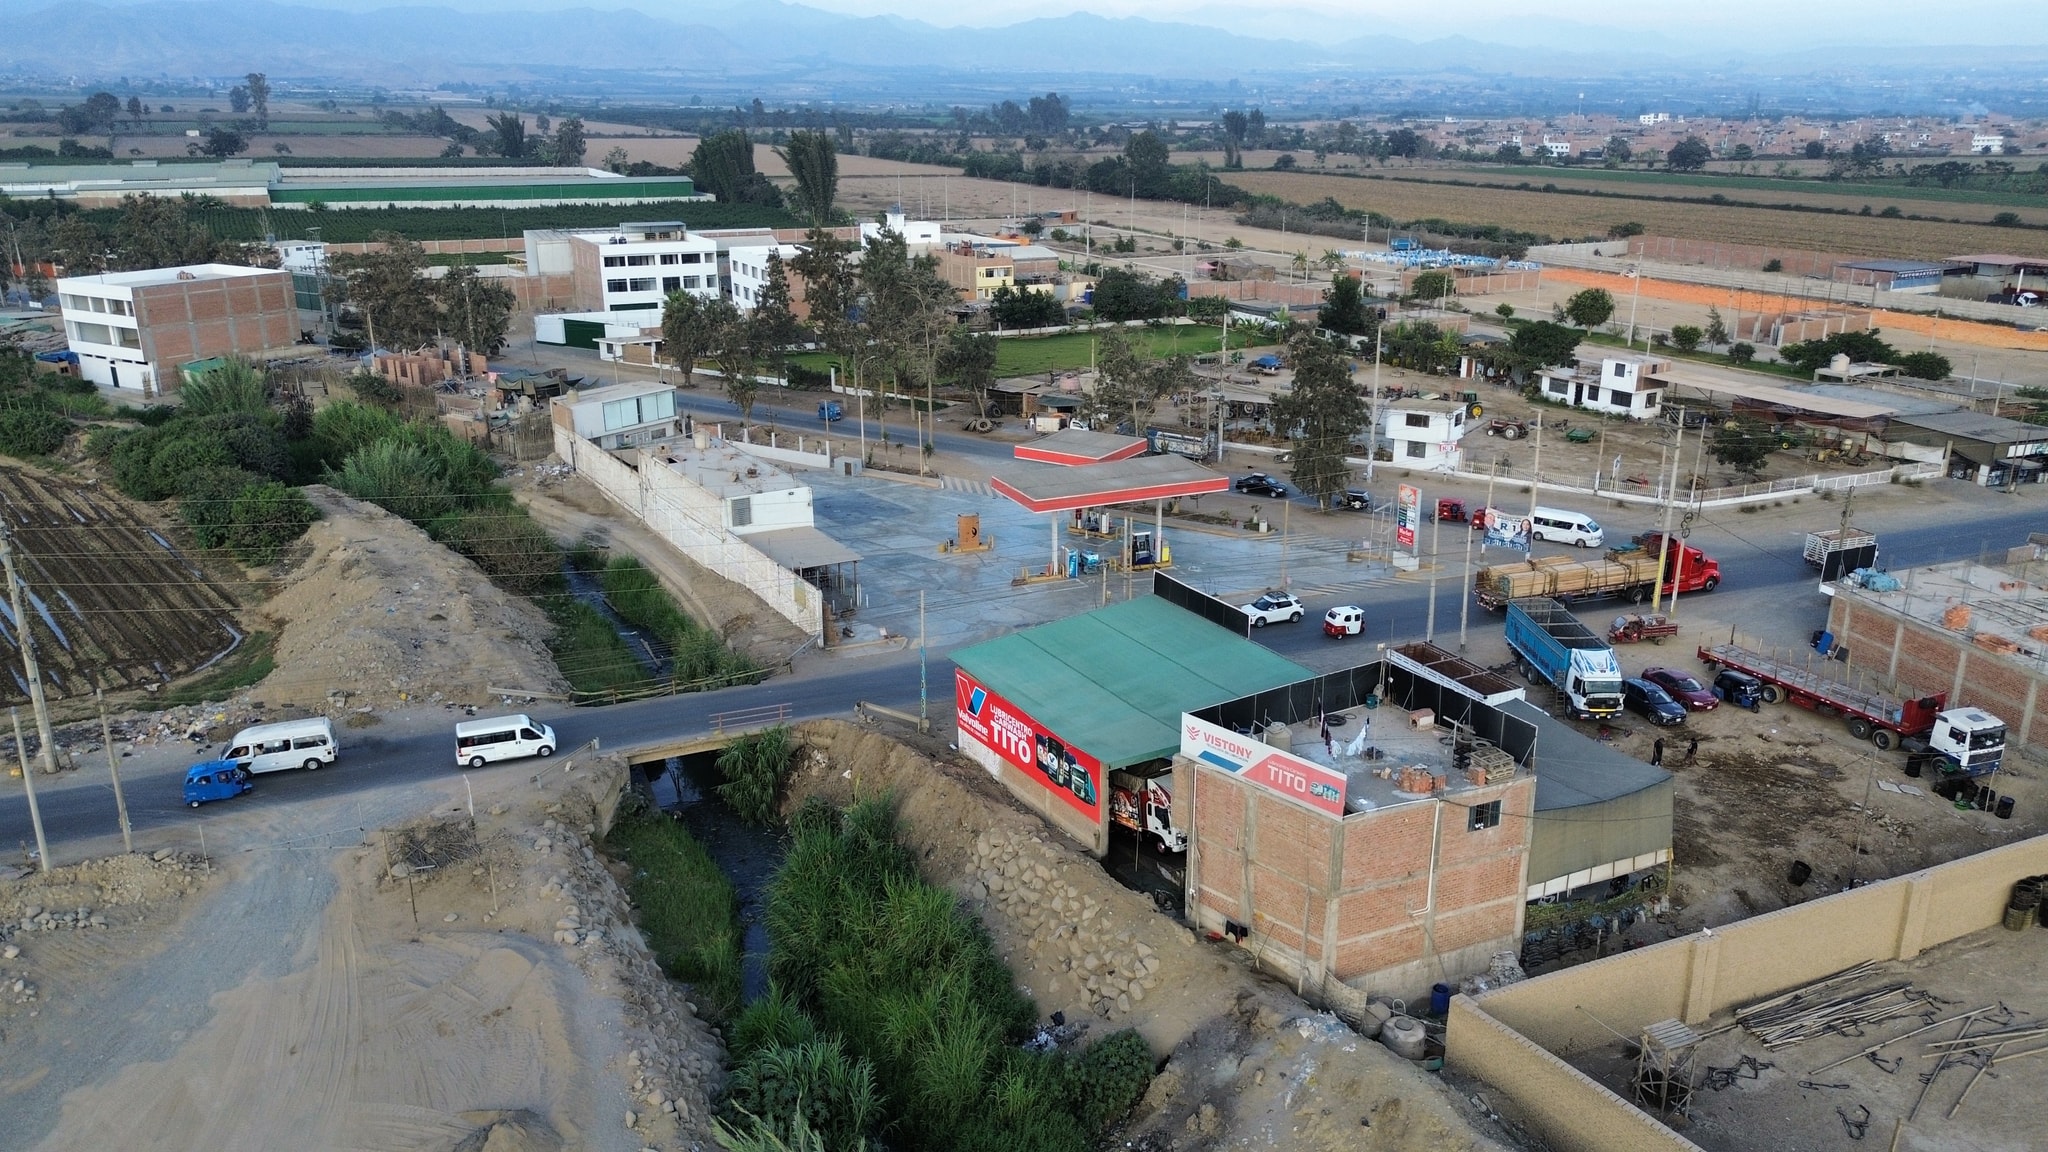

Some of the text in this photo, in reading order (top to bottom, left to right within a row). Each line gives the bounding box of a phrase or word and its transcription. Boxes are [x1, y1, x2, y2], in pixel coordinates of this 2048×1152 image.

[1500, 522, 1508, 530] R
[957, 707, 989, 736] Valvoline
[990, 703, 1033, 737] LUBRICENTRO
[994, 715, 1027, 740] CARWASH
[990, 720, 1031, 764] TITO
[1204, 732, 1252, 759] VISTONY
[1267, 764, 1307, 793] TITO
